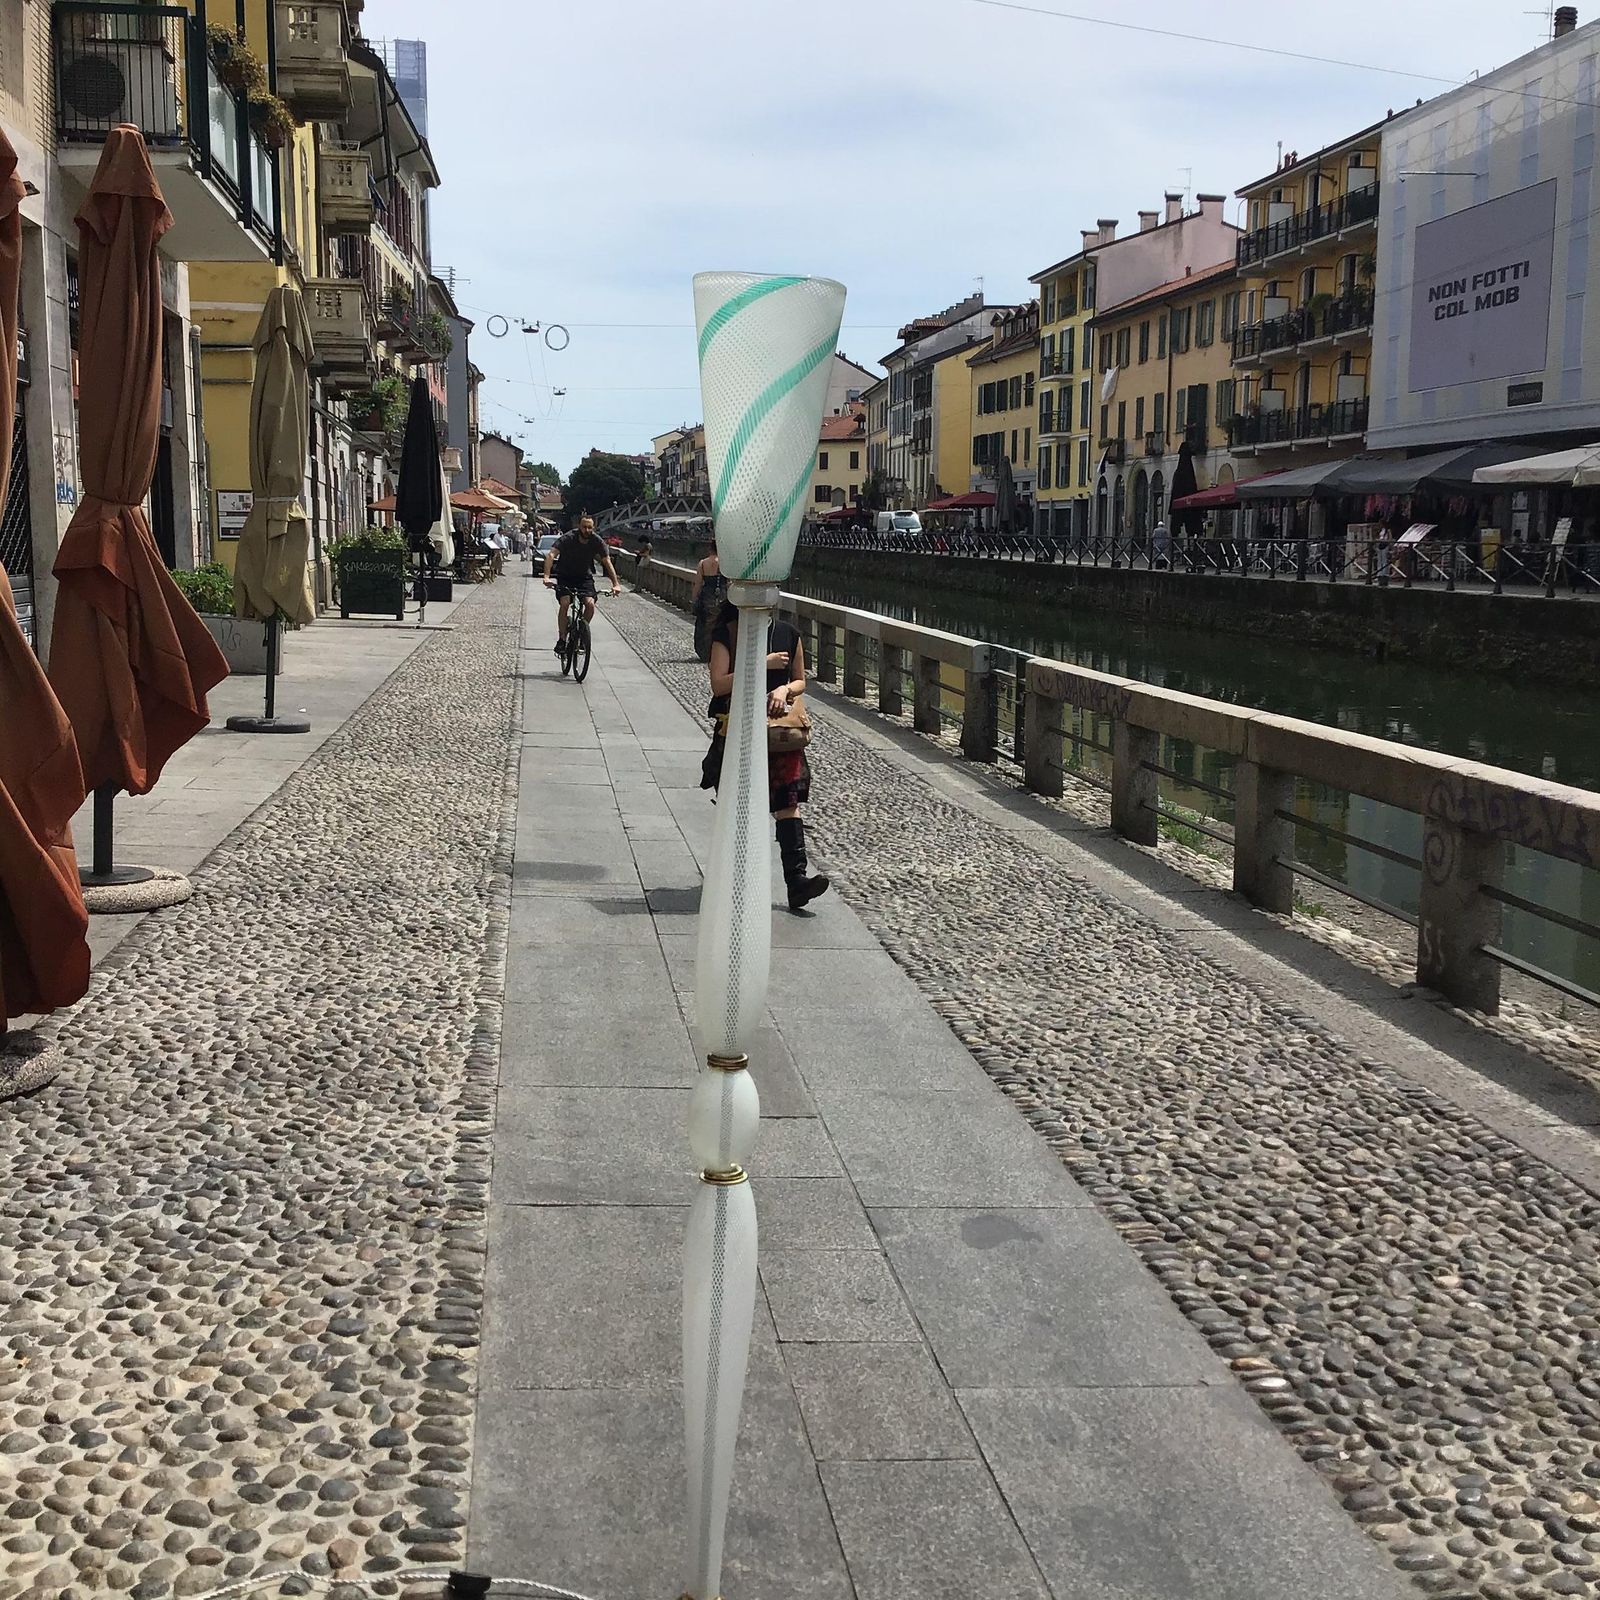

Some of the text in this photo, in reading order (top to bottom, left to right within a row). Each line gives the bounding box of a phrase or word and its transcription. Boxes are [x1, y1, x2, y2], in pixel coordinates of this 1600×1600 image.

[1428, 260, 1530, 303] NON FOTTI
[1434, 286, 1520, 321] COL MOB
